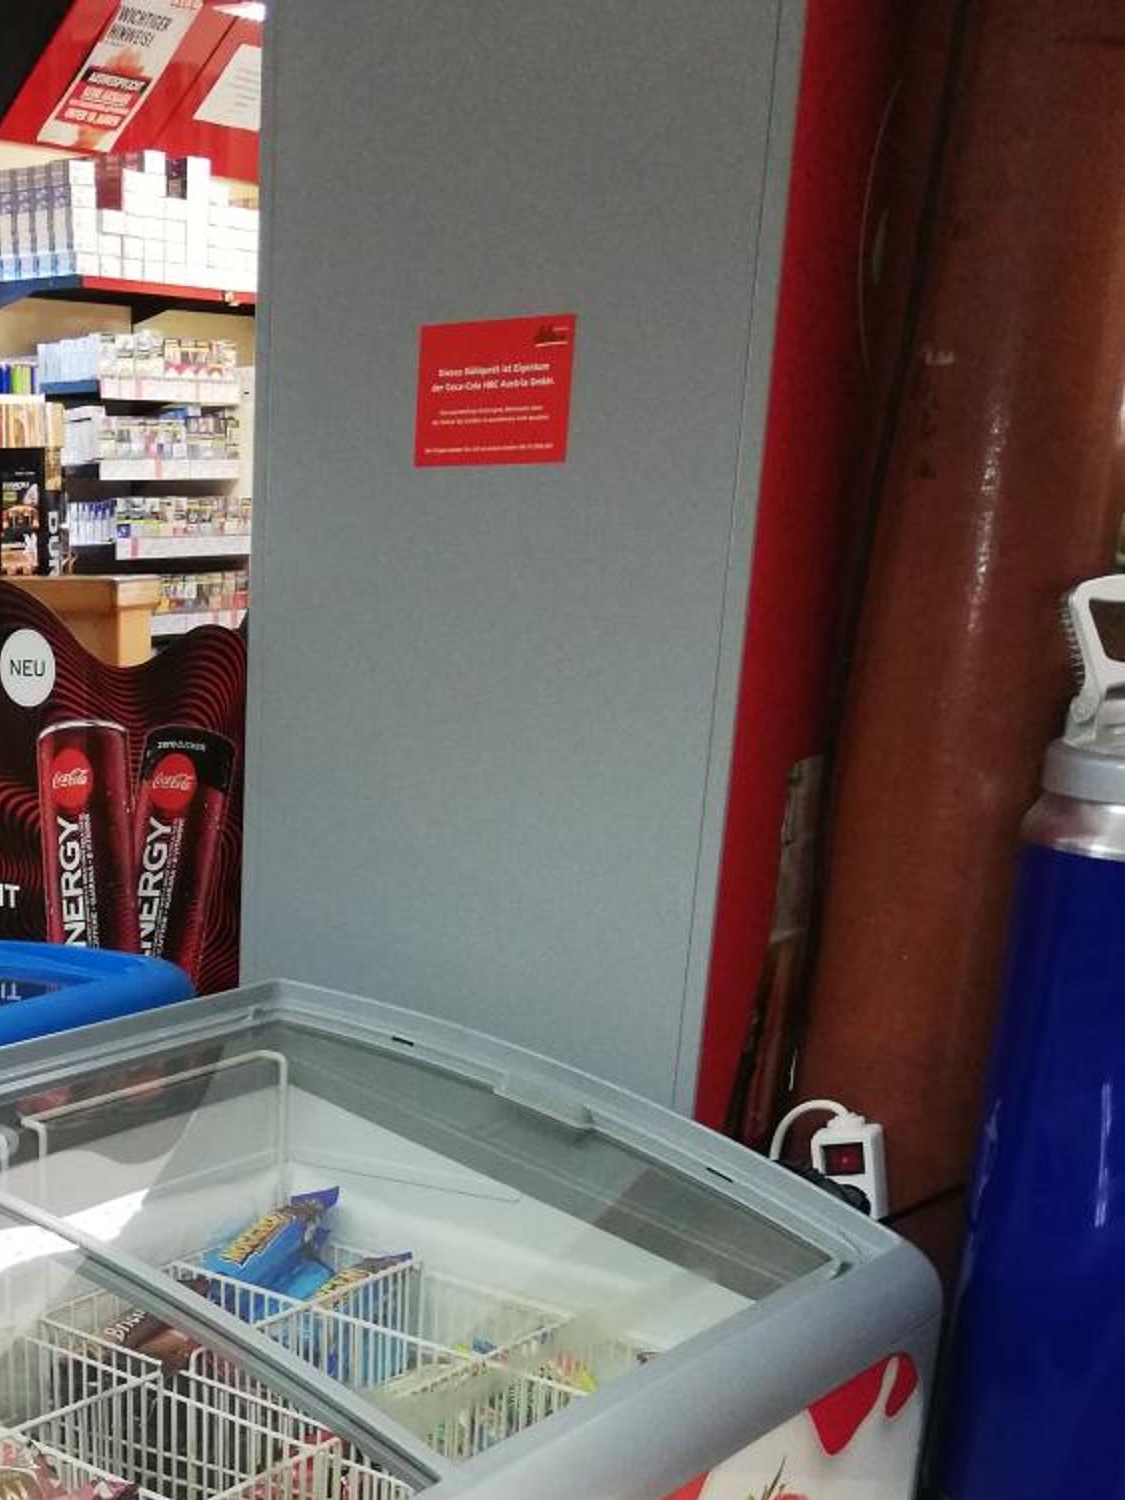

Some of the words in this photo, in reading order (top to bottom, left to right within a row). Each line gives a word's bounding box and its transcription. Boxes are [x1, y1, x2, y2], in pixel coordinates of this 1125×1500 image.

[10, 659, 45, 677] NEU
[57, 815, 86, 947] NERGY
[137, 817, 172, 954] NERGY
